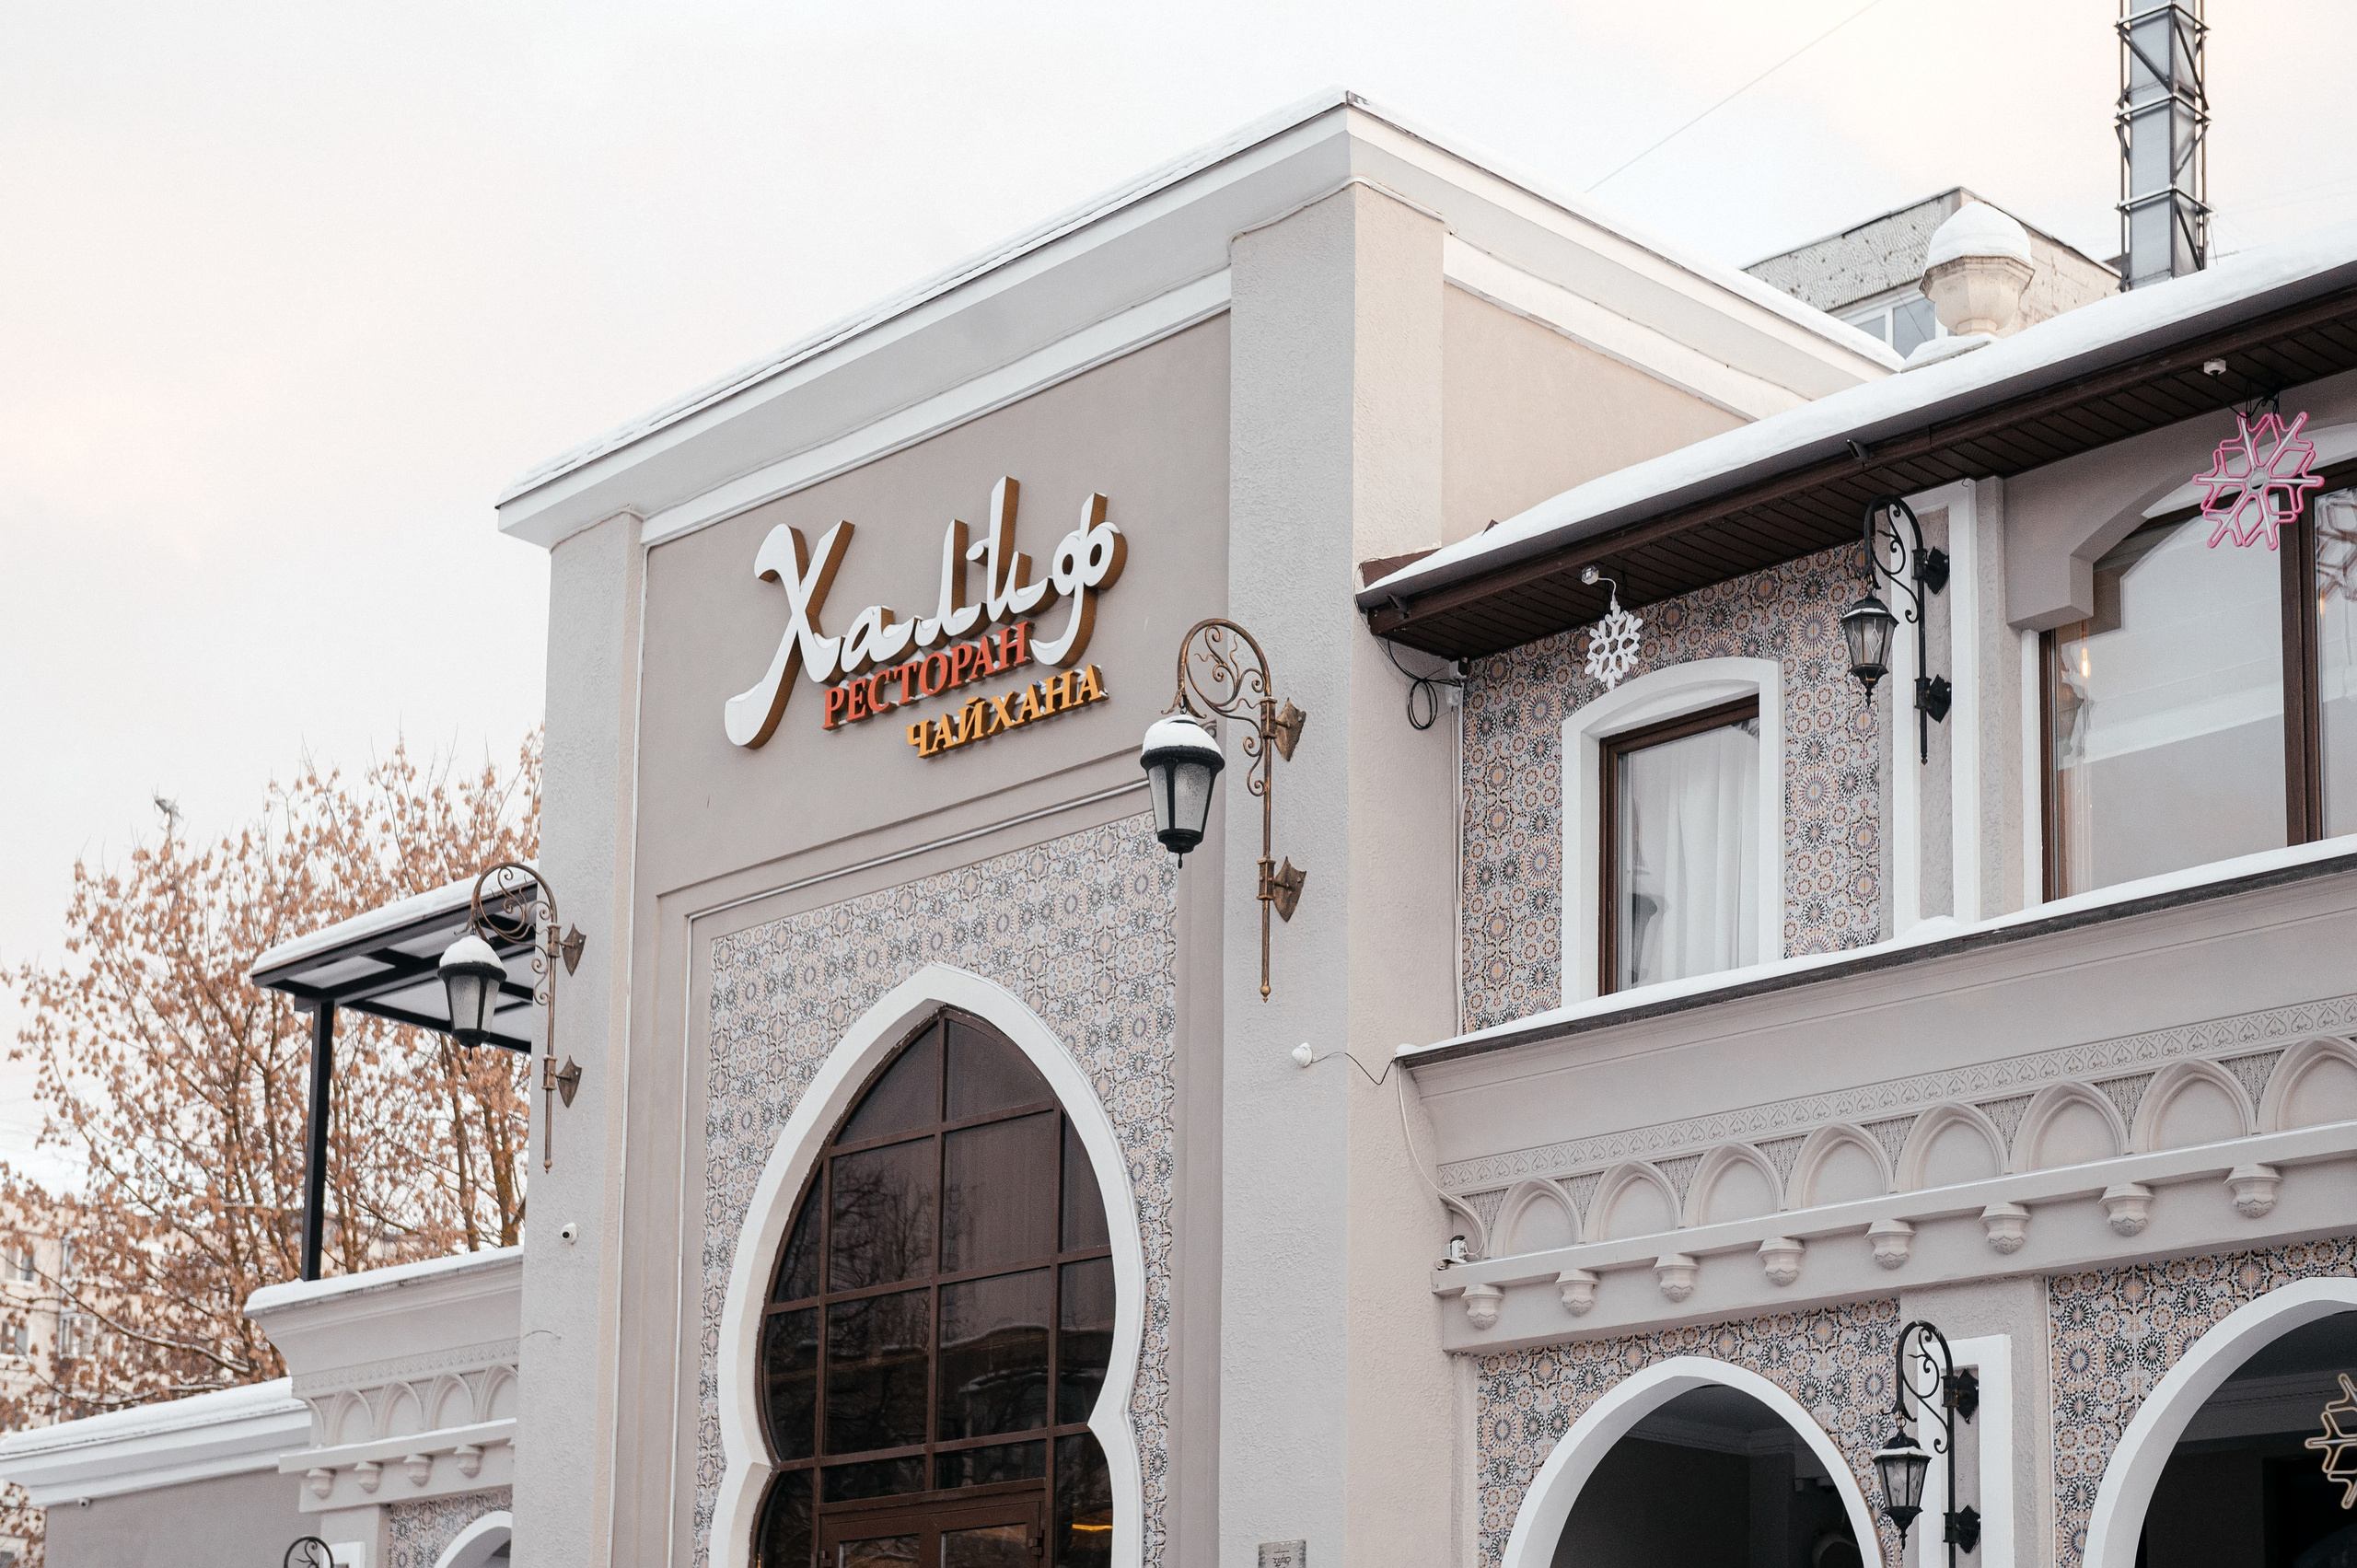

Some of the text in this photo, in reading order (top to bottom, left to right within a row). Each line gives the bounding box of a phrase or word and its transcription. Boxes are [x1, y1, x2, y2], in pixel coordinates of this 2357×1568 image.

[725, 476, 1127, 749] Халиф
[822, 621, 1034, 729] РЕСТОРАН
[906, 664, 1108, 758] ЧАЙХАНА
